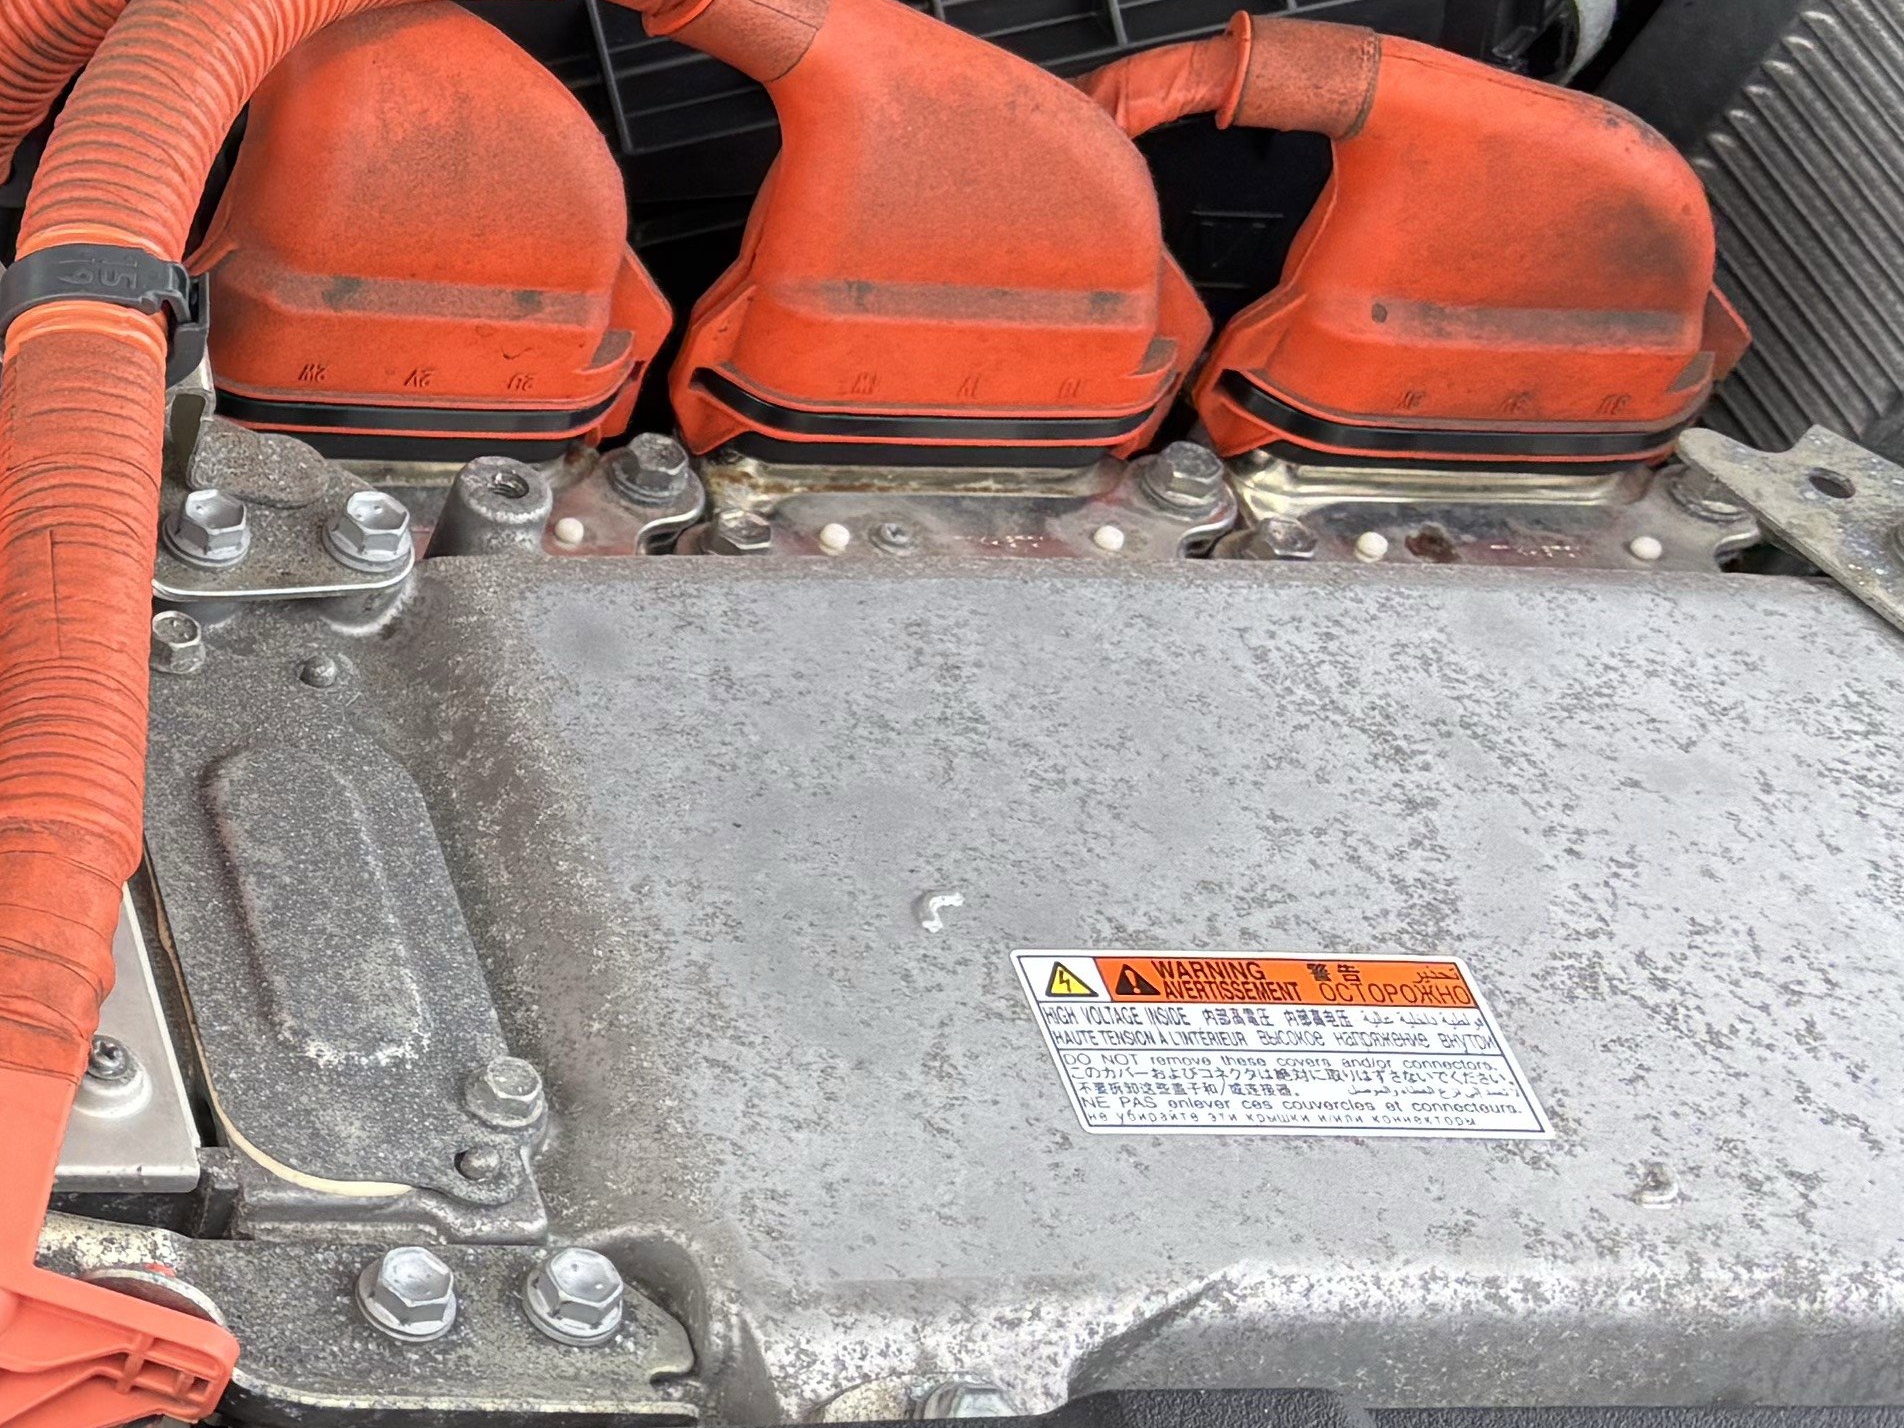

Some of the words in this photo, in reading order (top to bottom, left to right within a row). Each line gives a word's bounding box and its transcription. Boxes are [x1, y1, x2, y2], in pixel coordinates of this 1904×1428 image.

[1151, 960, 1267, 981] WARNING
[1306, 963, 1361, 983] 警告
[1162, 980, 1302, 1002] AVERTISSEMENT
[1319, 982, 1471, 1005] ОСТОРОЖНО
[1043, 1006, 1076, 1025] HIGH
[1081, 1006, 1143, 1026] VOLTAGE
[1144, 1007, 1191, 1026] INSIDE
[1051, 1029, 1097, 1046] HAUTE
[1101, 1030, 1155, 1046] TENSION
[1063, 1052, 1091, 1066] DO
[1101, 1053, 1139, 1066] NOT
[1150, 1056, 1211, 1066] remove
[1221, 1054, 1266, 1067] these
[1276, 1057, 1331, 1067] covers
[1342, 1055, 1392, 1069] and/or
[1402, 1058, 1498, 1071] connectors.
[1081, 1096, 1111, 1109] NE
[1119, 1096, 1158, 1109] PAS
[1168, 1097, 1230, 1109] enlever
[1241, 1100, 1273, 1110] ces
[1282, 1099, 1376, 1112] couvercles
[1385, 1100, 1401, 1112] et
